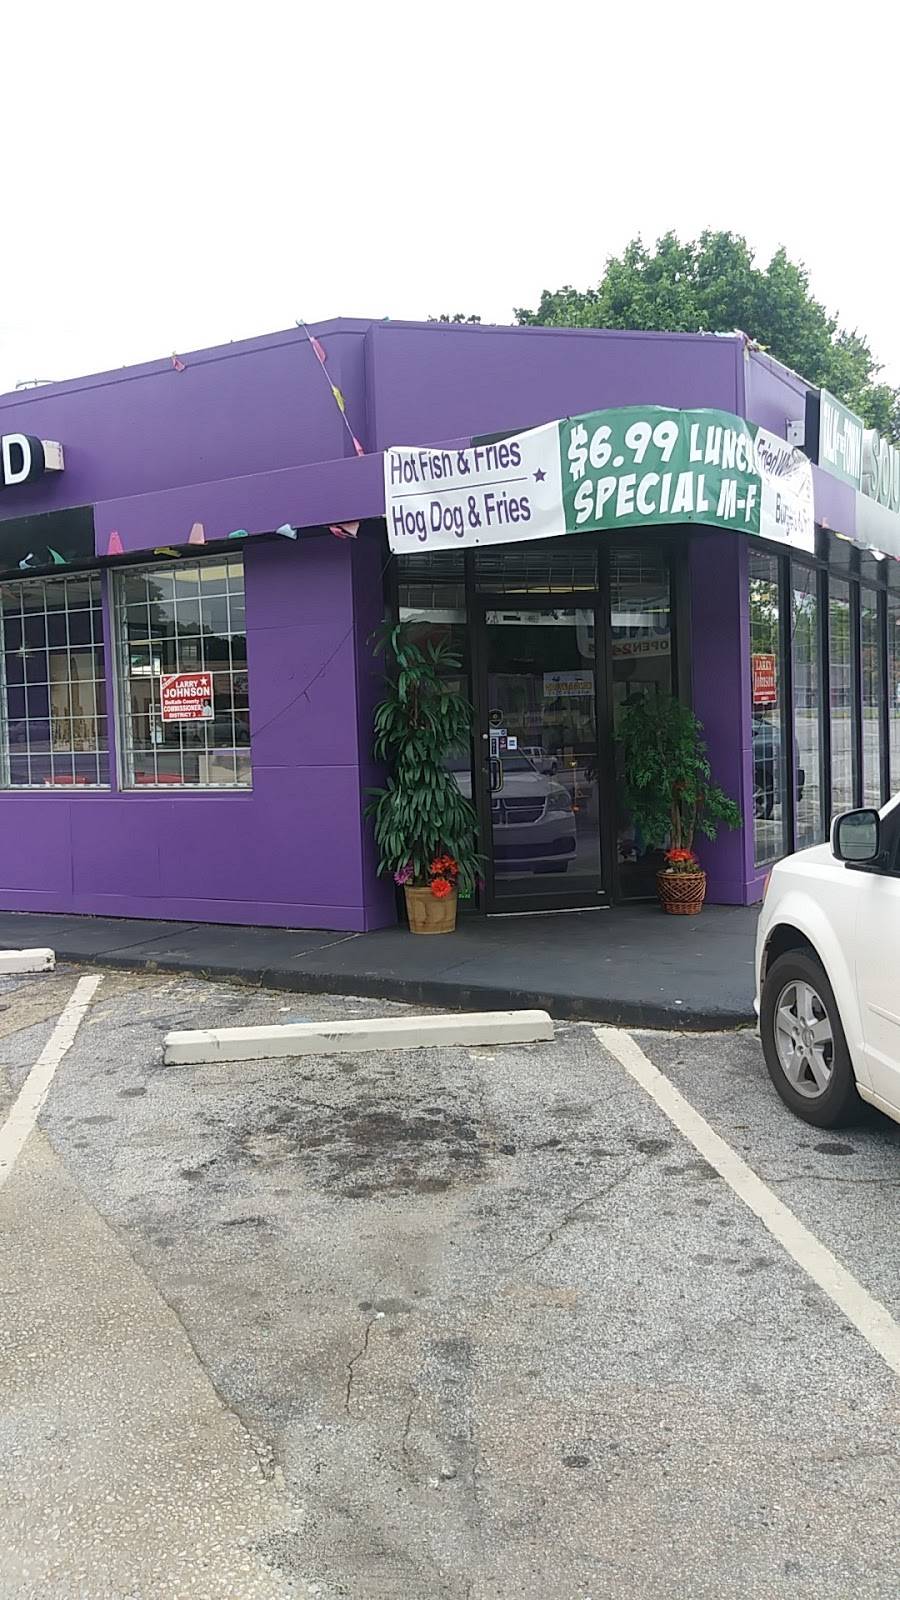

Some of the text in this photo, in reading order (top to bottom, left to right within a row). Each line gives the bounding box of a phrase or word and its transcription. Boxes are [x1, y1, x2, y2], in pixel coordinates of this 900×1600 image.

[2, 433, 31, 485] D
[391, 442, 521, 485] Hot Fish & Fries
[568, 420, 679, 481] $6.99
[392, 491, 531, 542] Hog Dog & Fries
[574, 471, 708, 524] SPECIAL
[716, 478, 757, 522] M-F
[164, 687, 209, 697] JOHNSON
[175, 680, 199, 688] LARRY
